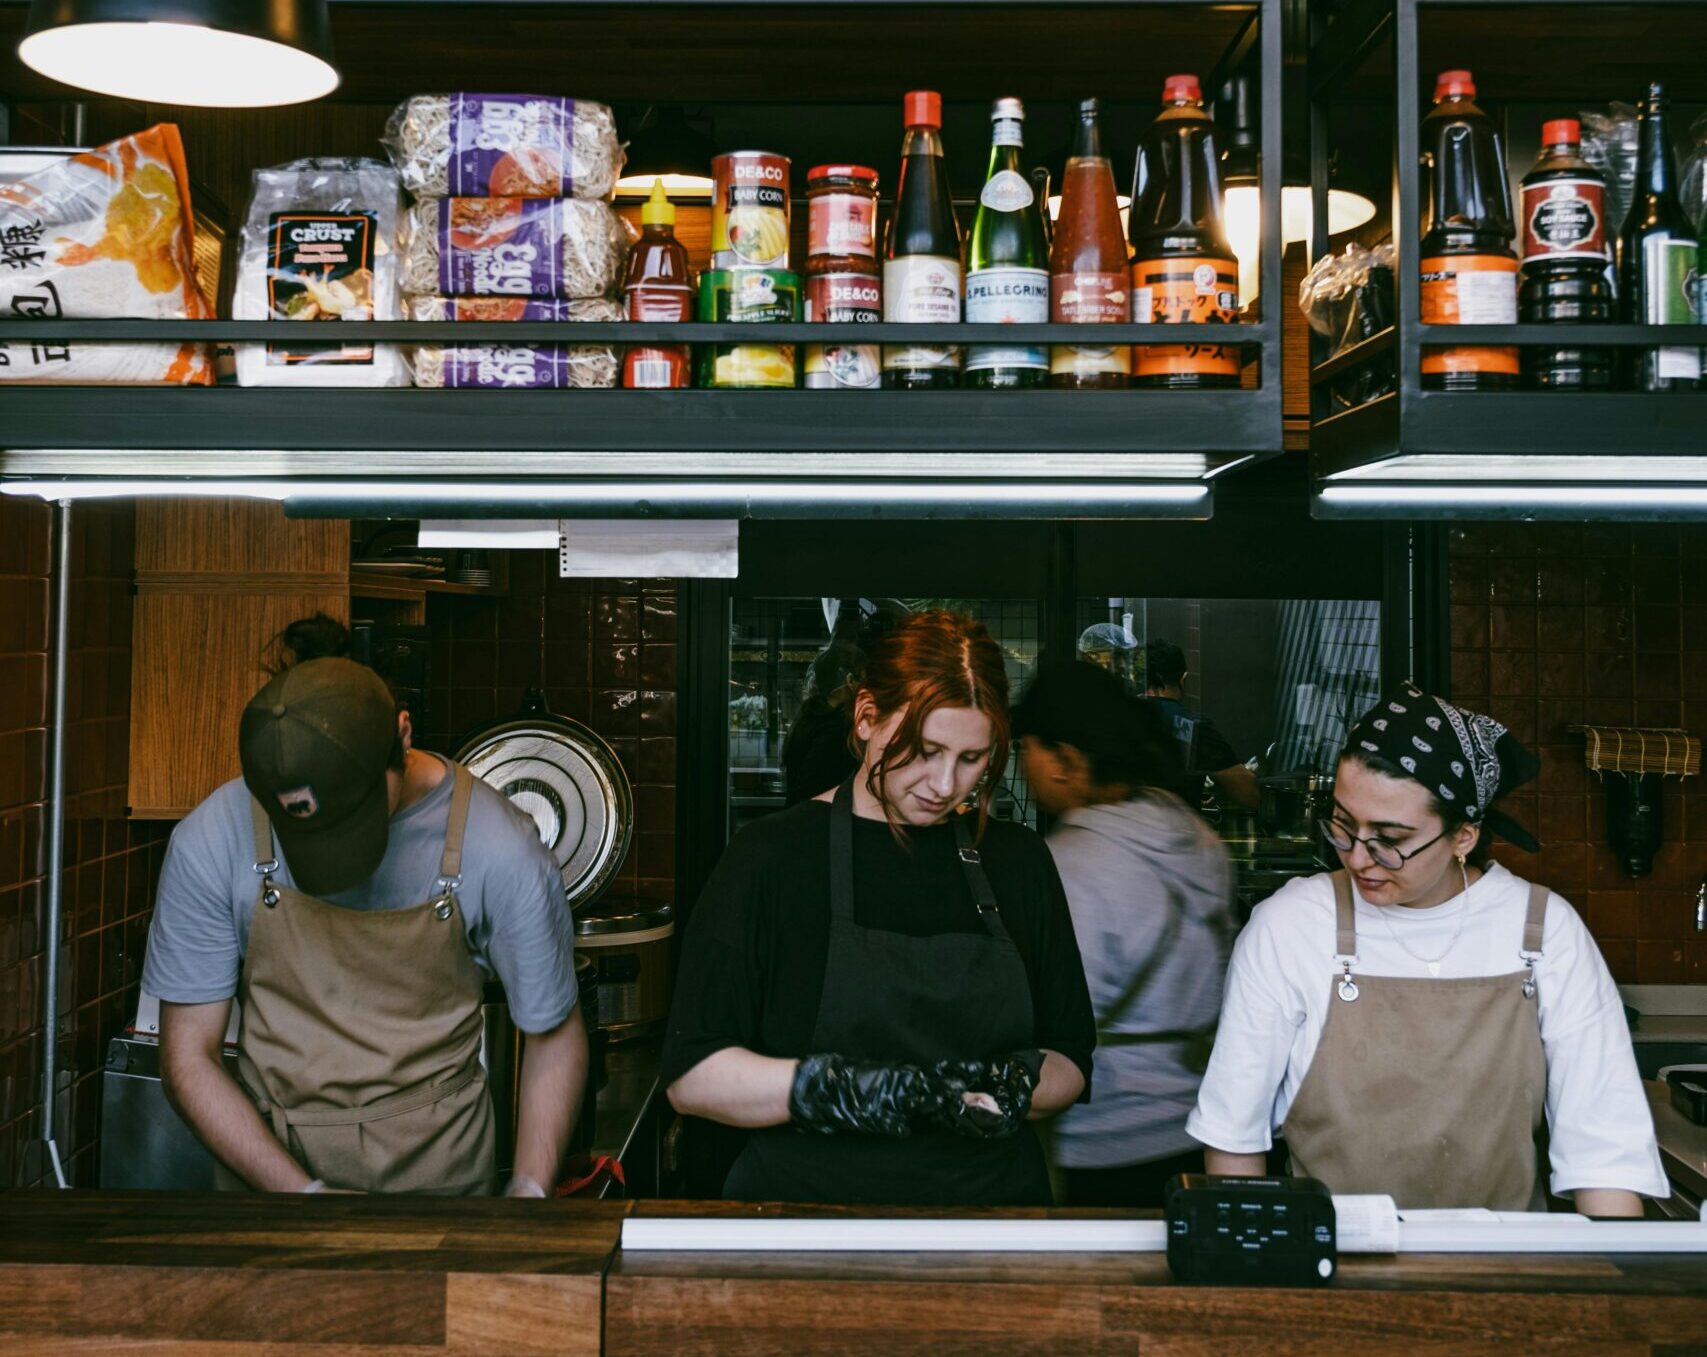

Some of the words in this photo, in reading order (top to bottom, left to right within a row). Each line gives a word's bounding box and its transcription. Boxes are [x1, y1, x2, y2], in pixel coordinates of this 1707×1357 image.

[475, 101, 525, 151] Egg
[734, 166, 783, 180] DE&CO
[734, 189, 758, 200] BABY
[759, 190, 784, 202] CORN
[1559, 213, 1587, 223] SAUCE
[290, 228, 356, 242] CRUST
[472, 248, 493, 294] Noodle
[484, 244, 538, 294] Egg
[831, 287, 879, 302] DE&CO
[829, 310, 855, 322] BABY
[856, 311, 879, 322] CORN
